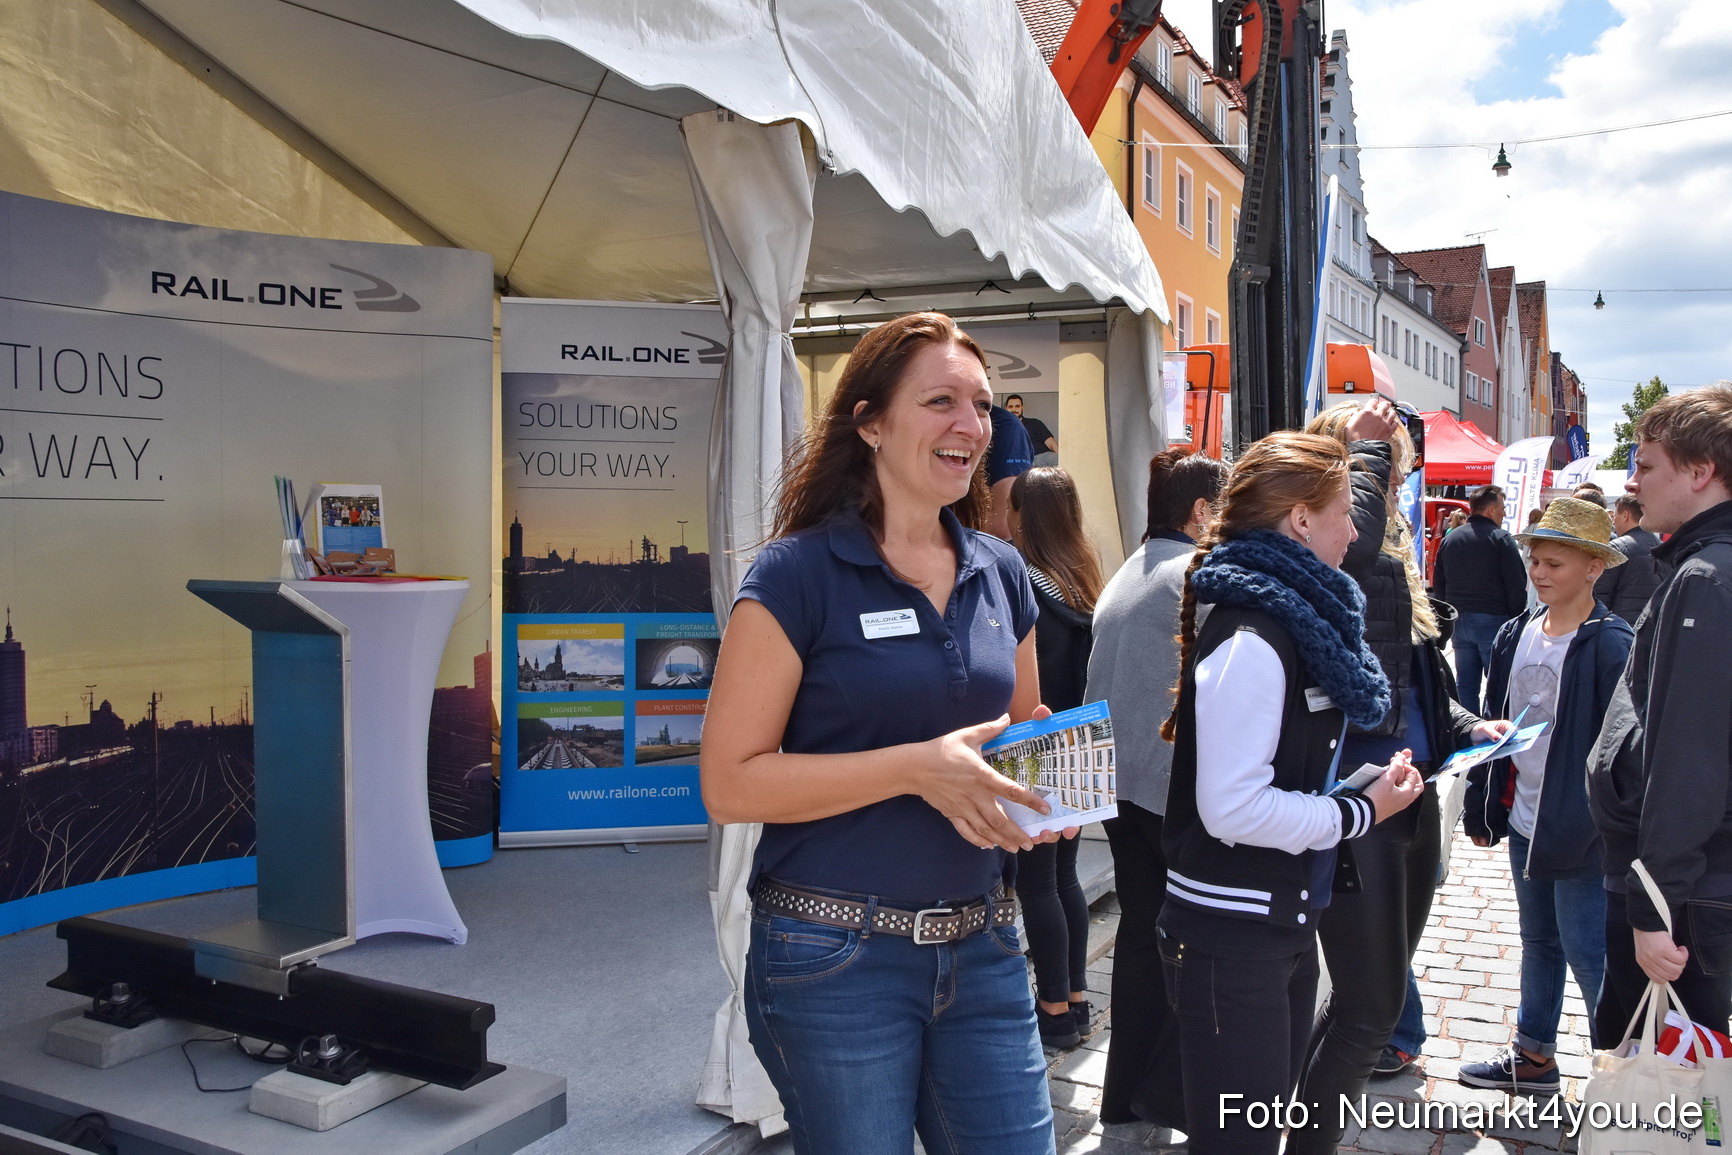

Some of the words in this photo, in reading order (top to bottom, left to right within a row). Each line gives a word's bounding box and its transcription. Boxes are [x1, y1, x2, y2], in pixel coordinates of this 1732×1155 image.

[151, 271, 343, 310] RAIL.ONE
[561, 344, 690, 363] RAIL.ONE
[0, 342, 164, 400] TIONS
[519, 402, 678, 431] SOLUTIONS
[29, 432, 163, 481] WAY.
[518, 451, 597, 477] YOUR
[606, 453, 675, 479] WAY.
[567, 785, 690, 801] www.railone.com
